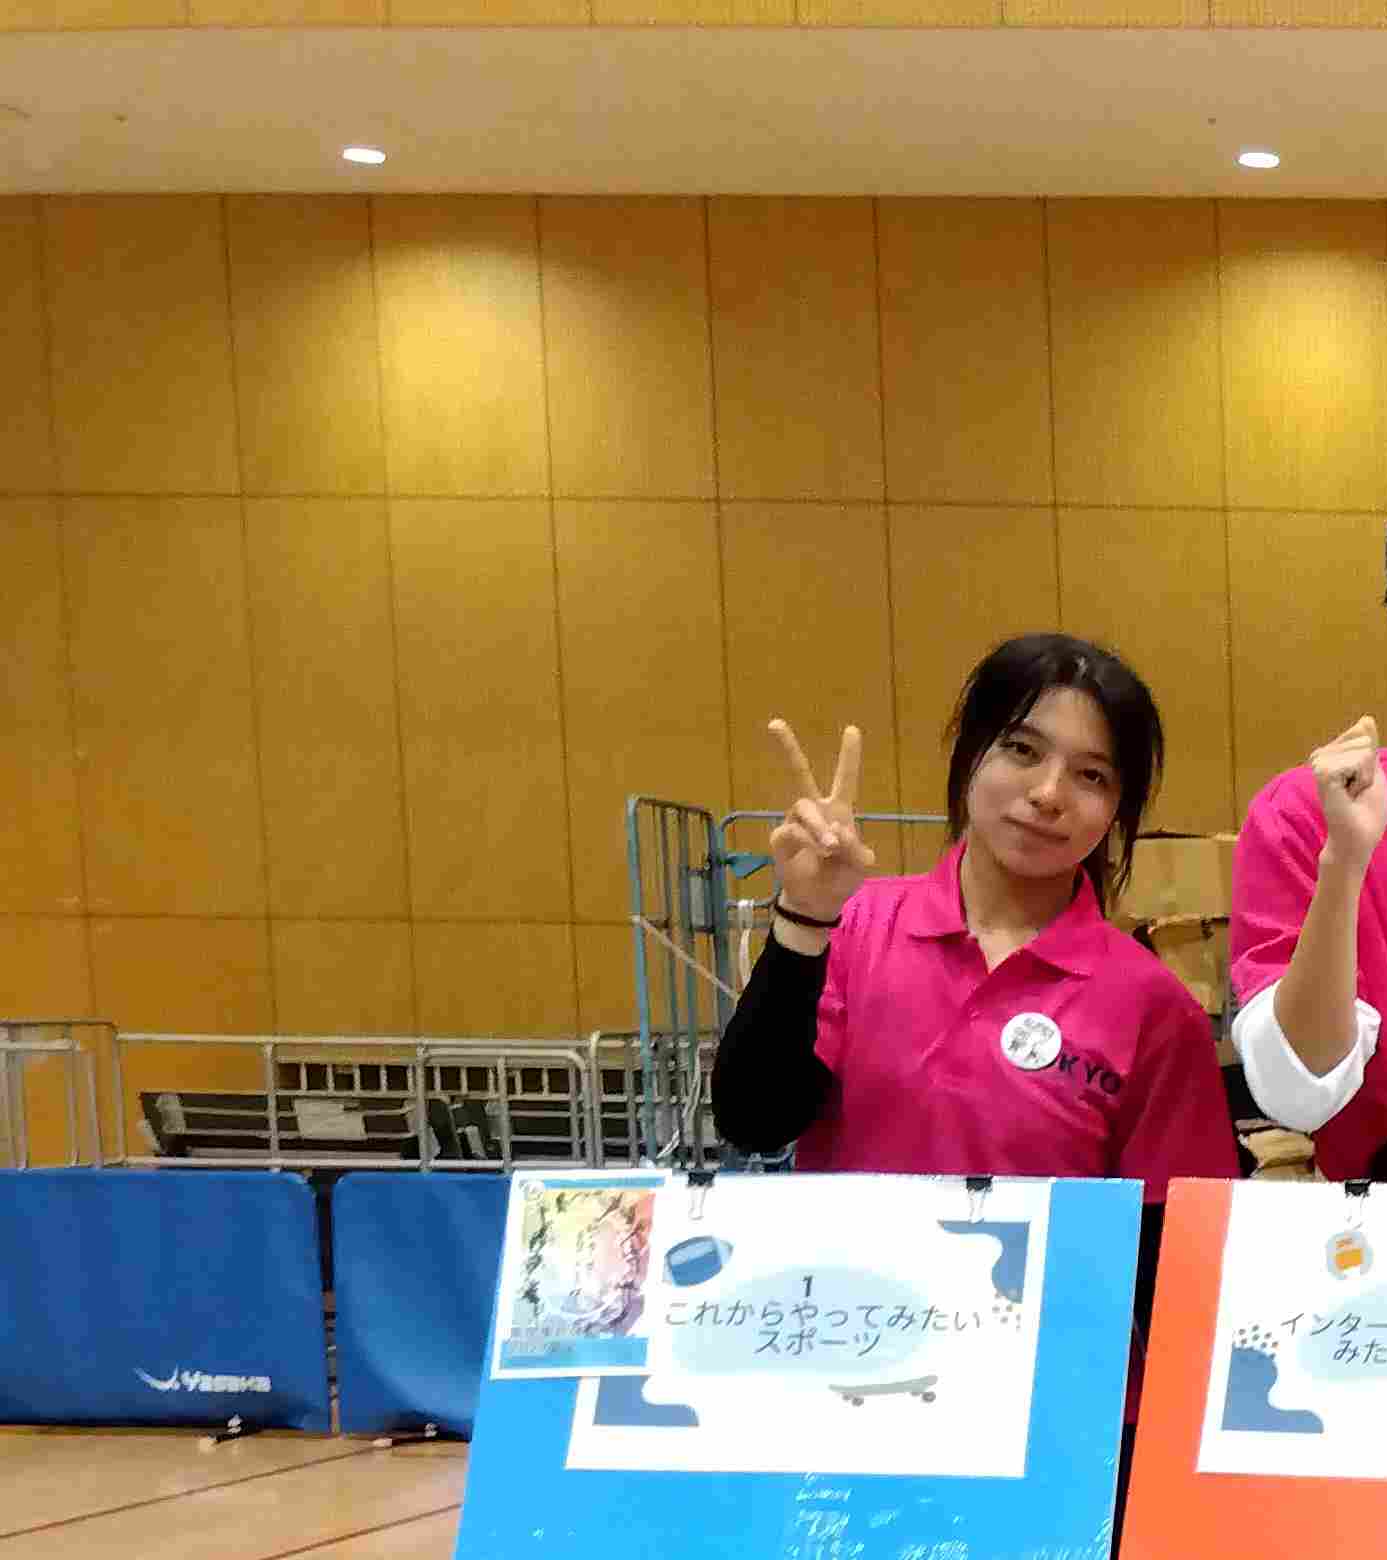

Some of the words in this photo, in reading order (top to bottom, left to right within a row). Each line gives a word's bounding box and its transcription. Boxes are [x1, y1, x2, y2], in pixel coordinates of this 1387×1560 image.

[803, 1275, 814, 1298] 1
[664, 1299, 983, 1333] これからやってみたい
[753, 1330, 883, 1357] スポーツ
